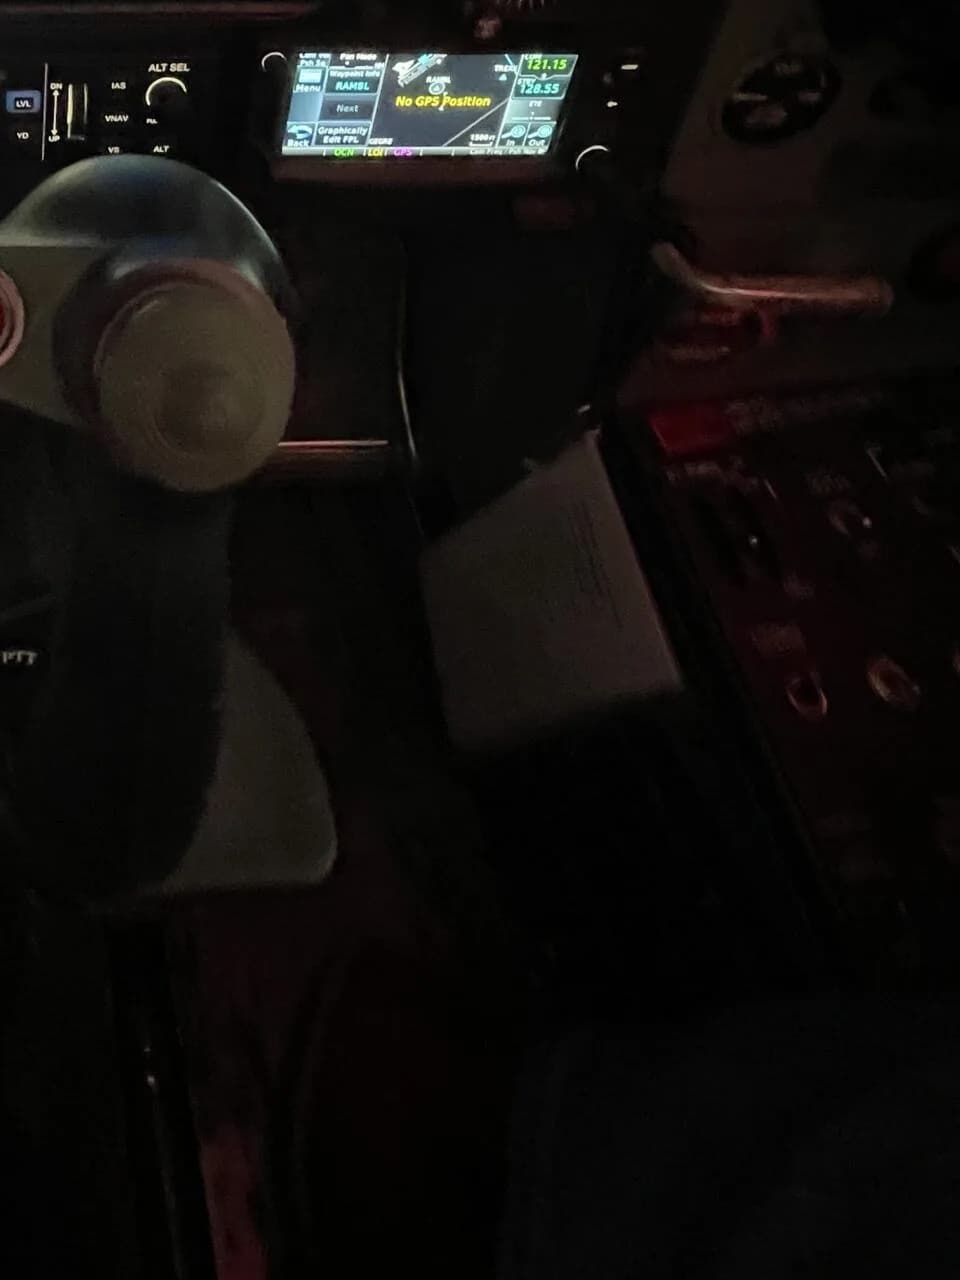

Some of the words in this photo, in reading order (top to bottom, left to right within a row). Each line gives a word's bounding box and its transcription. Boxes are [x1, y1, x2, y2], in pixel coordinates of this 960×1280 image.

[147, 63, 168, 73] ALT
[169, 63, 191, 72] SEL
[527, 59, 567, 70] 121.15
[50, 82, 63, 90] DN
[111, 81, 127, 90] IAS
[296, 84, 321, 92] Menu
[520, 83, 560, 94] 128.55
[15, 100, 31, 108] LVL
[395, 96, 413, 106] No
[415, 96, 440, 107] GPS
[442, 96, 491, 107] Position
[336, 104, 359, 112] Next
[318, 126, 368, 136] Graphically
[16, 131, 30, 140] YD
[48, 134, 61, 143] UP
[323, 135, 341, 143] Edit
[342, 135, 360, 144] FPL
[287, 139, 309, 147] Back
[506, 139, 516, 147] In
[528, 139, 545, 147] Out
[108, 146, 120, 154] VS
[153, 144, 170, 153] ALT
[334, 148, 354, 156] OCN
[394, 148, 412, 156] GPS
